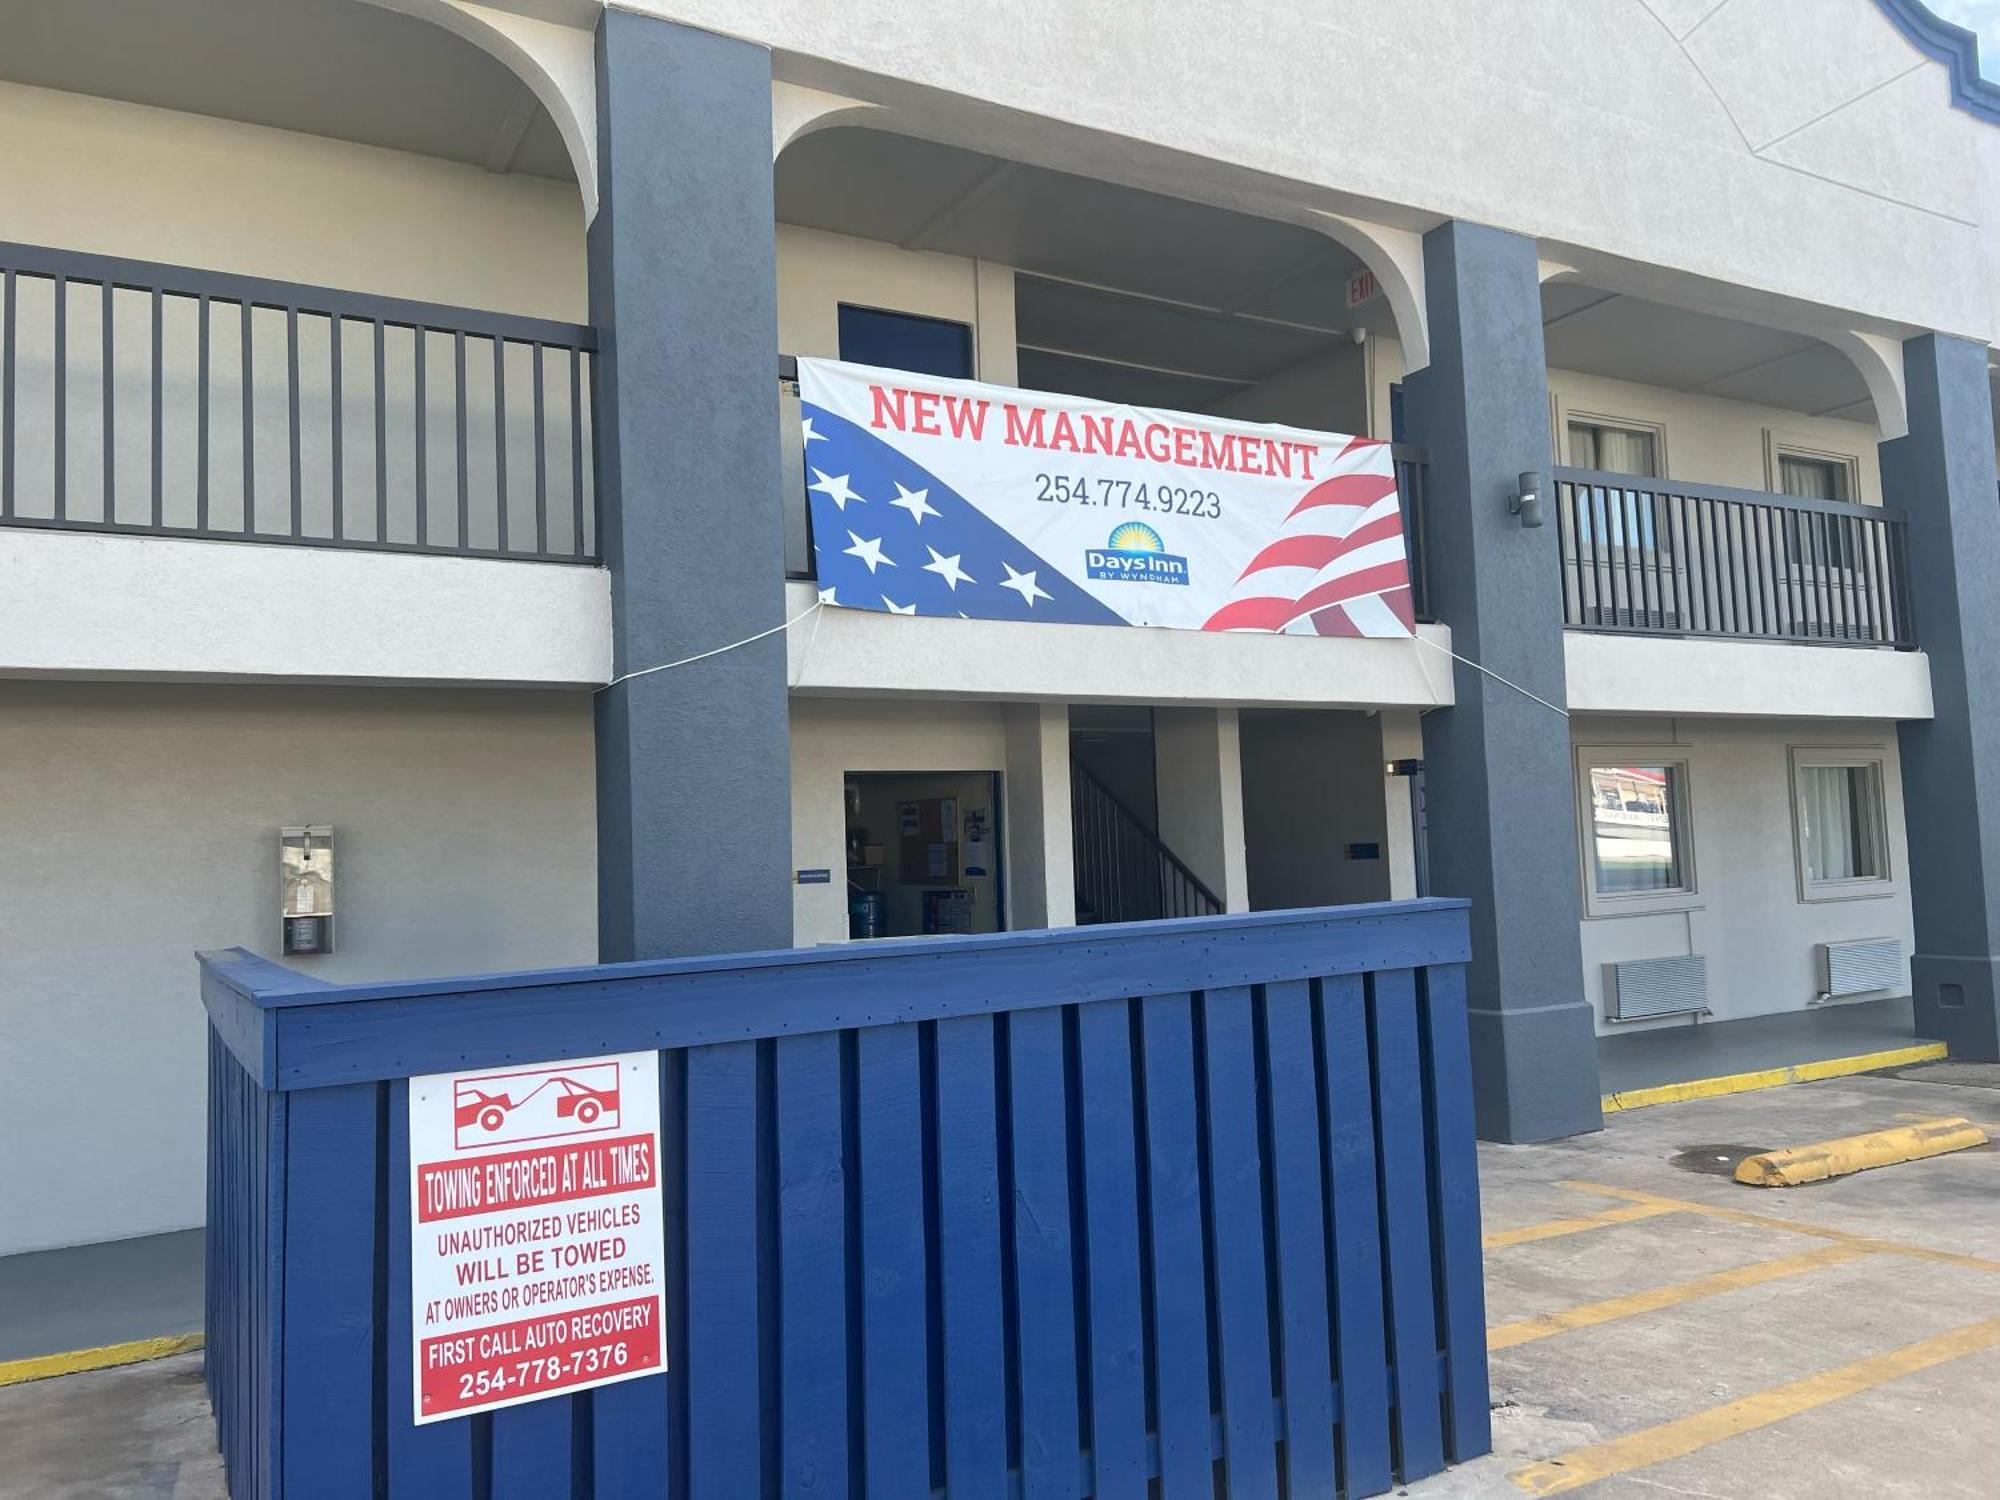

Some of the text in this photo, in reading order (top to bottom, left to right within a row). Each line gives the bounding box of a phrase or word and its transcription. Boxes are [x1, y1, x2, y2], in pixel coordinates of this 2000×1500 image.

[869, 385, 1319, 480] NEW MANAGEMENT
[1035, 474, 1222, 520] 254.774.9223
[1088, 552, 1183, 573] Days Inn
[1099, 571, 1179, 584] BY WYNDHAM
[425, 1142, 650, 1213] TOWING ENFORCED AT ALL TIMES
[438, 1203, 641, 1257] UNAUTHORIZED VEHICLES
[456, 1237, 626, 1286] WILL BE TOWED
[425, 1263, 655, 1325] AT OWNERS OR OPERATOR'S EXPENSE.
[429, 1303, 652, 1369] FIRST CALL AUTO RECOVERY
[459, 1342, 628, 1400] 254-778-7376
